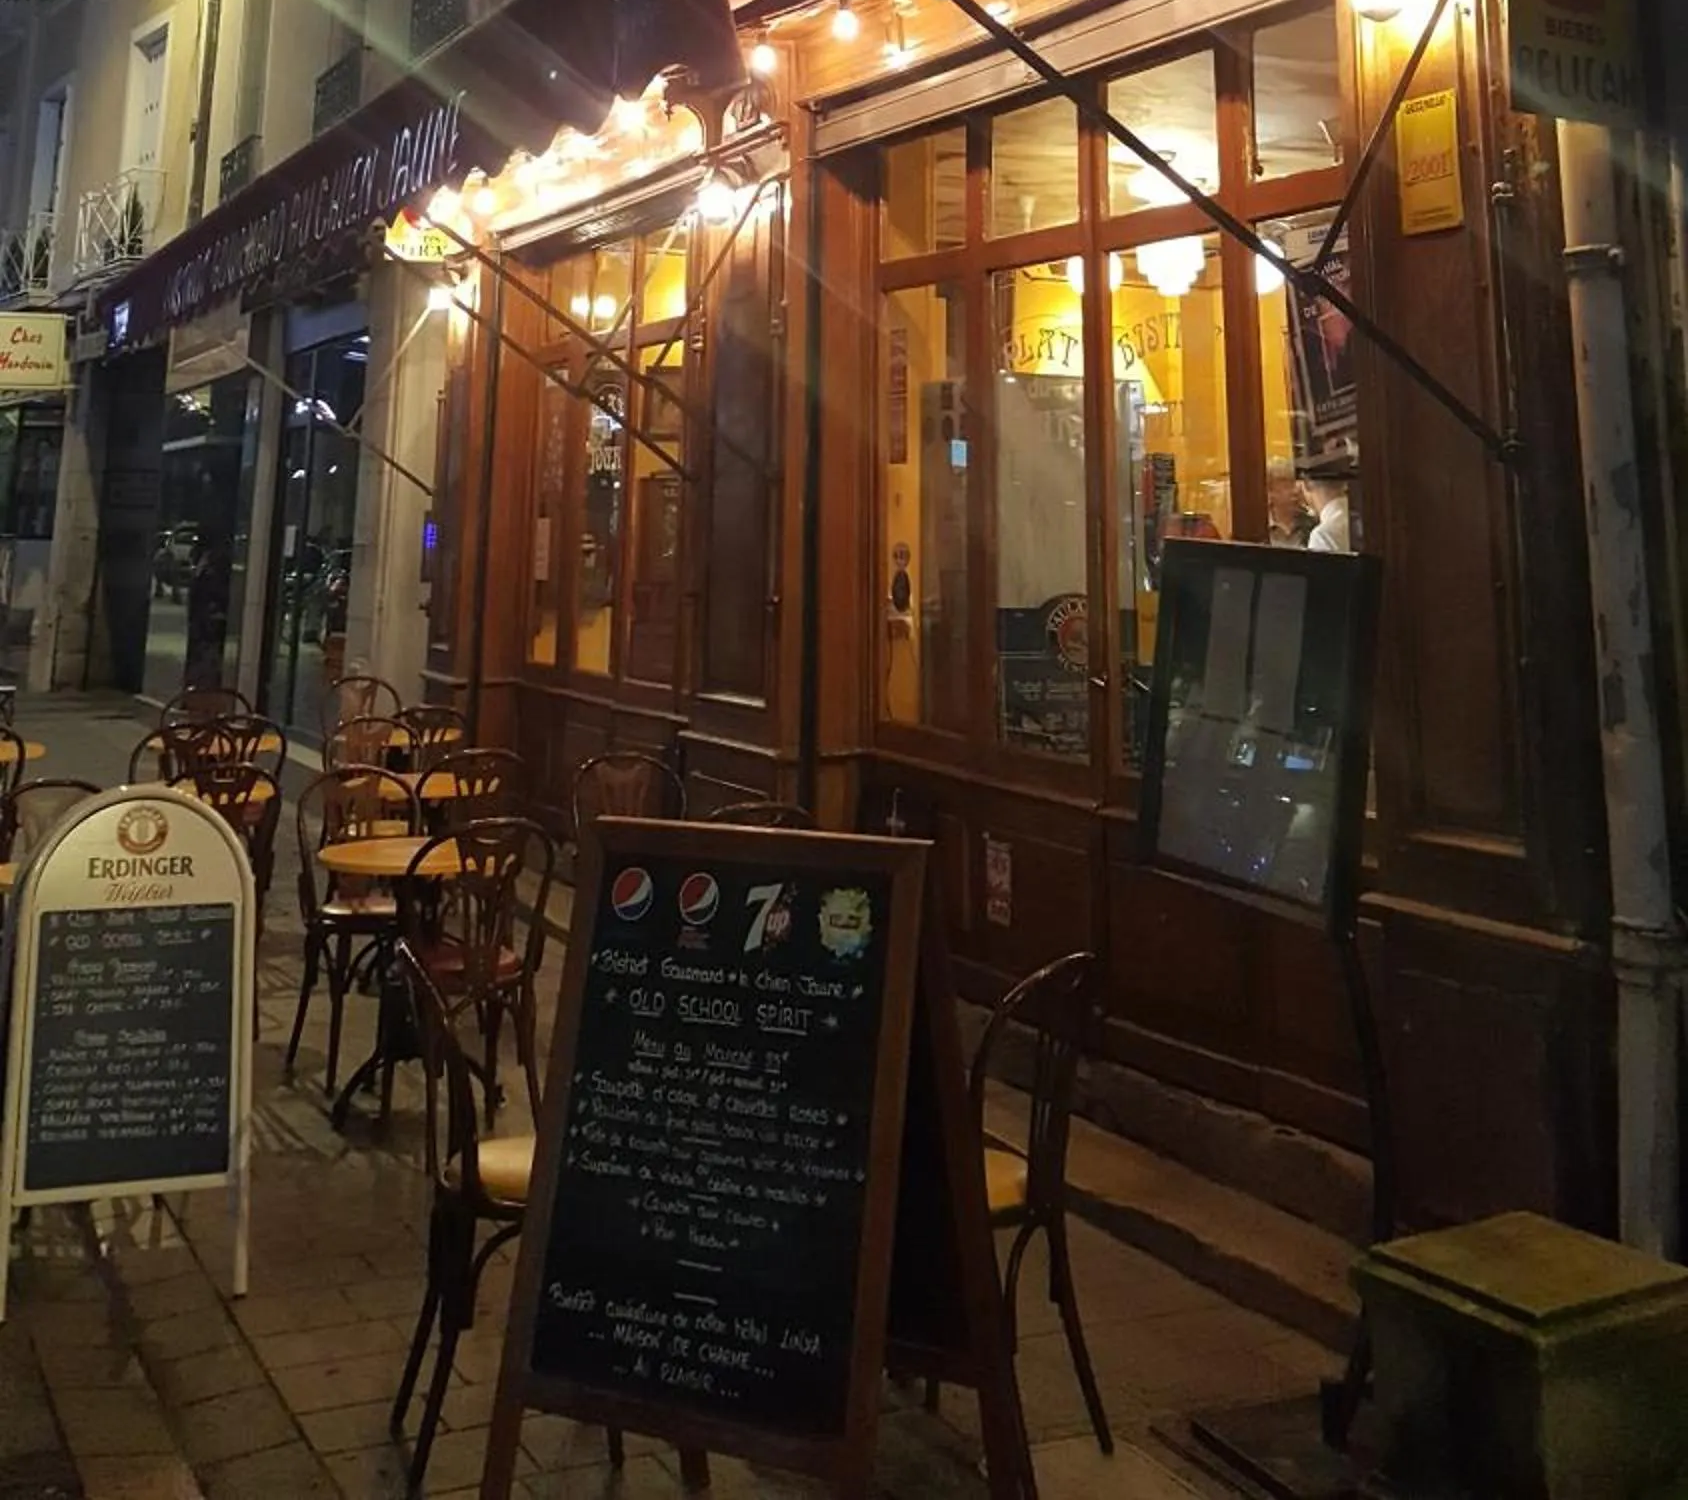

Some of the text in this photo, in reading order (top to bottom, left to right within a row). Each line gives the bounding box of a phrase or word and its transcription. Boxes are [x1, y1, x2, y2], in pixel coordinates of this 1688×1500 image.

[88, 855, 194, 881] ERDINGER
[628, 987, 665, 1013] OLD
[676, 994, 743, 1023] SCHOOL
